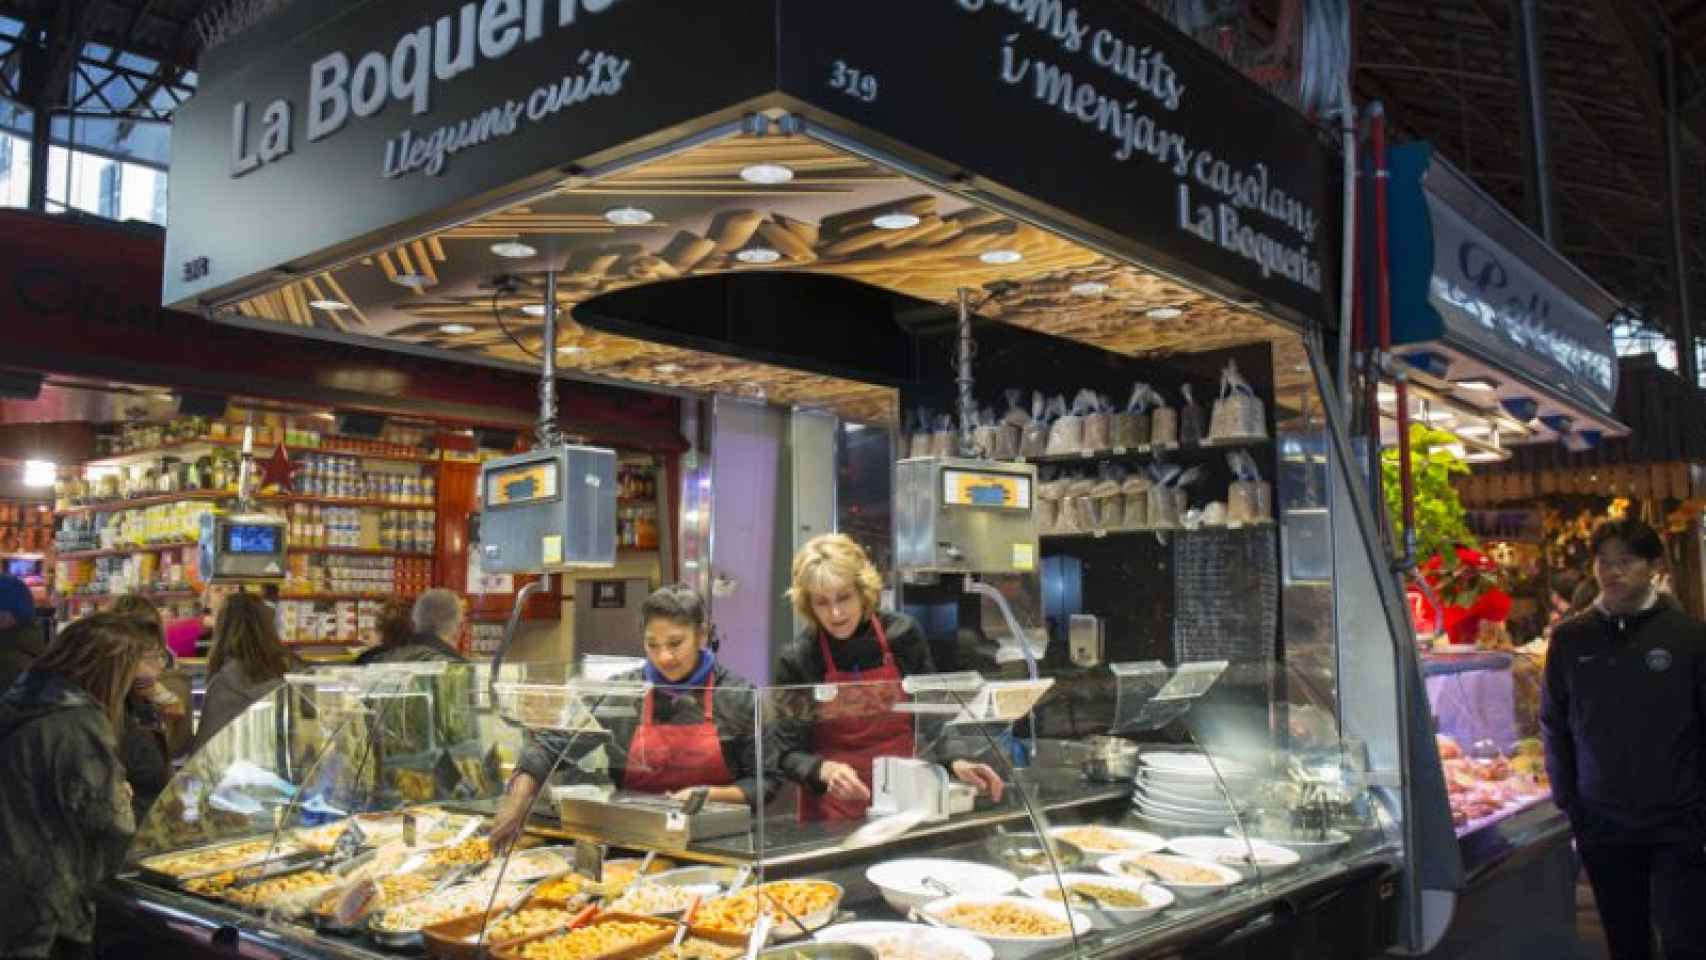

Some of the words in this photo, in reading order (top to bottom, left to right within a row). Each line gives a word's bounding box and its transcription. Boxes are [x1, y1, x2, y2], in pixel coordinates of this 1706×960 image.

[230, 98, 293, 178] La
[307, 0, 616, 143] Boquer
[383, 99, 523, 178] Llegums
[527, 49, 631, 121] cuits
[829, 61, 877, 101] 319
[1092, 29, 1184, 110] cuits
[1034, 61, 1192, 176] menjars
[1195, 150, 1319, 242] casolans
[1178, 183, 1214, 241] La
[1218, 202, 1320, 292] Boqueria
